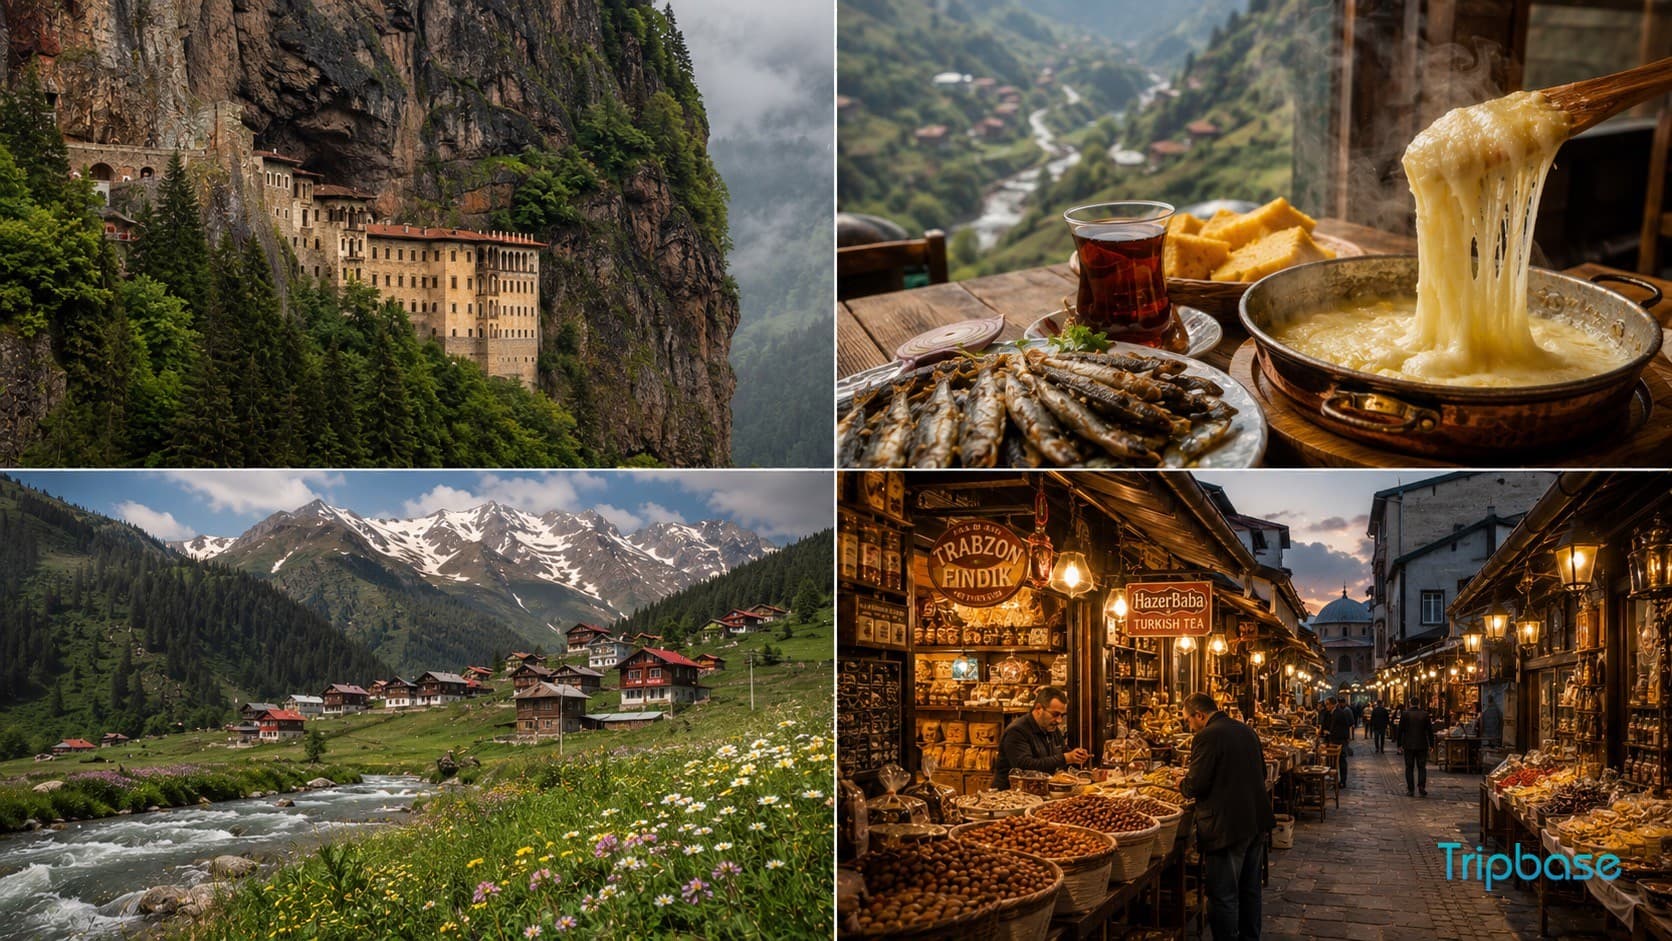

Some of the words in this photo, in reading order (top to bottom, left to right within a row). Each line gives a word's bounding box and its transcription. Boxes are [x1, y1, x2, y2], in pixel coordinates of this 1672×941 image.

[933, 535, 1024, 566] TRABZON
[942, 567, 1013, 588] FINDIK
[1134, 592, 1204, 609] HazerBaba
[1134, 618, 1180, 630] TURKISH
[1184, 617, 1204, 629] TEA
